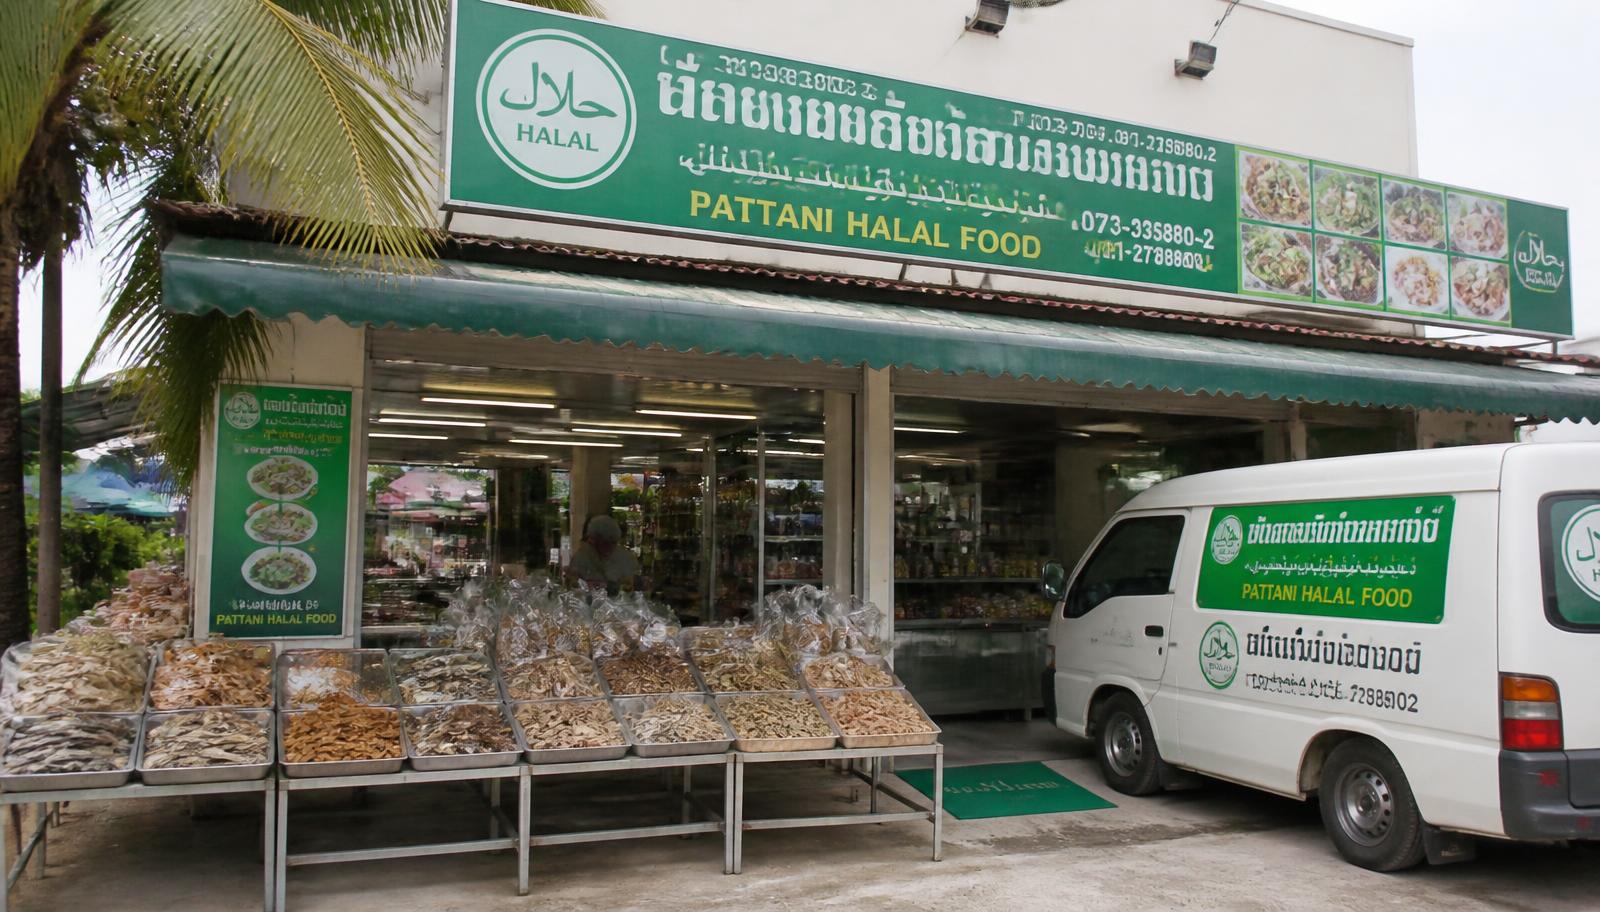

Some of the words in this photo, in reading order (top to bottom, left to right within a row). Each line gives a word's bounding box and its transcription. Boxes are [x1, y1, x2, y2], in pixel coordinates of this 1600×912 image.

[499, 62, 618, 118] حلال
[516, 122, 599, 152] HALAL
[690, 190, 833, 233] PATTANI
[847, 211, 949, 248] HALAL
[960, 226, 1042, 260] FOOD
[1241, 583, 1298, 602] PATTANI
[1301, 585, 1355, 605] HALAL
[1361, 587, 1413, 608] FOOD
[216, 614, 264, 625] PATTANI
[267, 614, 303, 625] HALAL
[305, 613, 337, 624] FOOD
